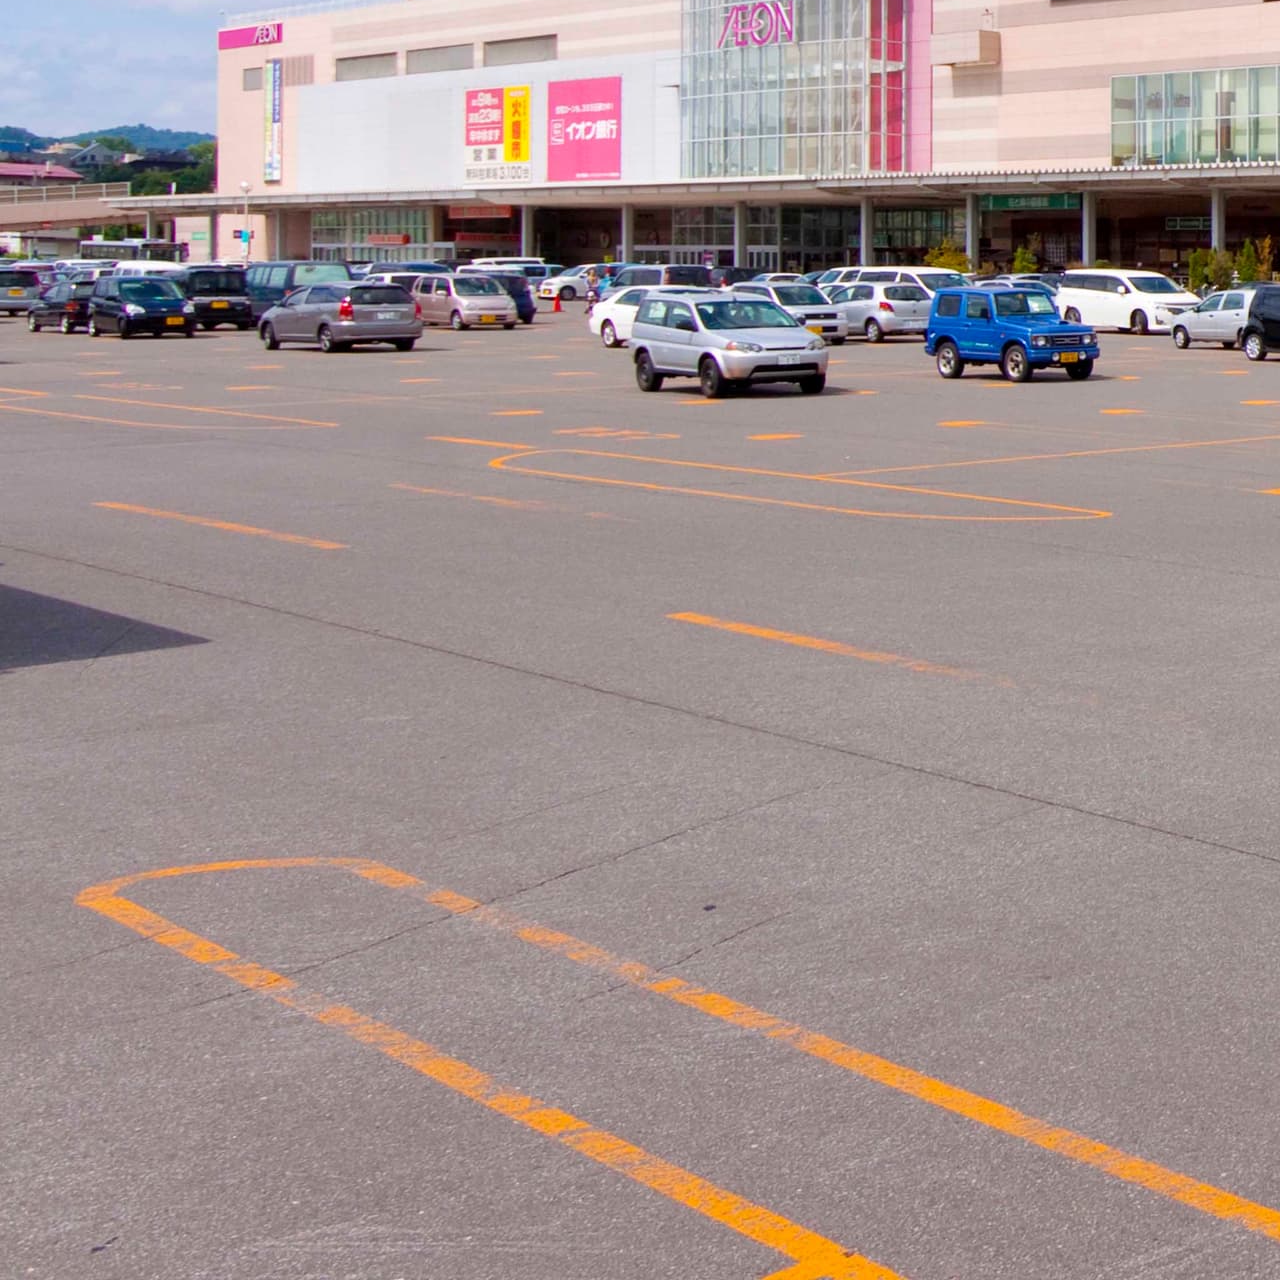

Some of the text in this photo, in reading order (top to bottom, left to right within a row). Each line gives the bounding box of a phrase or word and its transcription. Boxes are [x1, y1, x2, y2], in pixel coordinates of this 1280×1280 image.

[565, 119, 618, 141] イオン銀行
